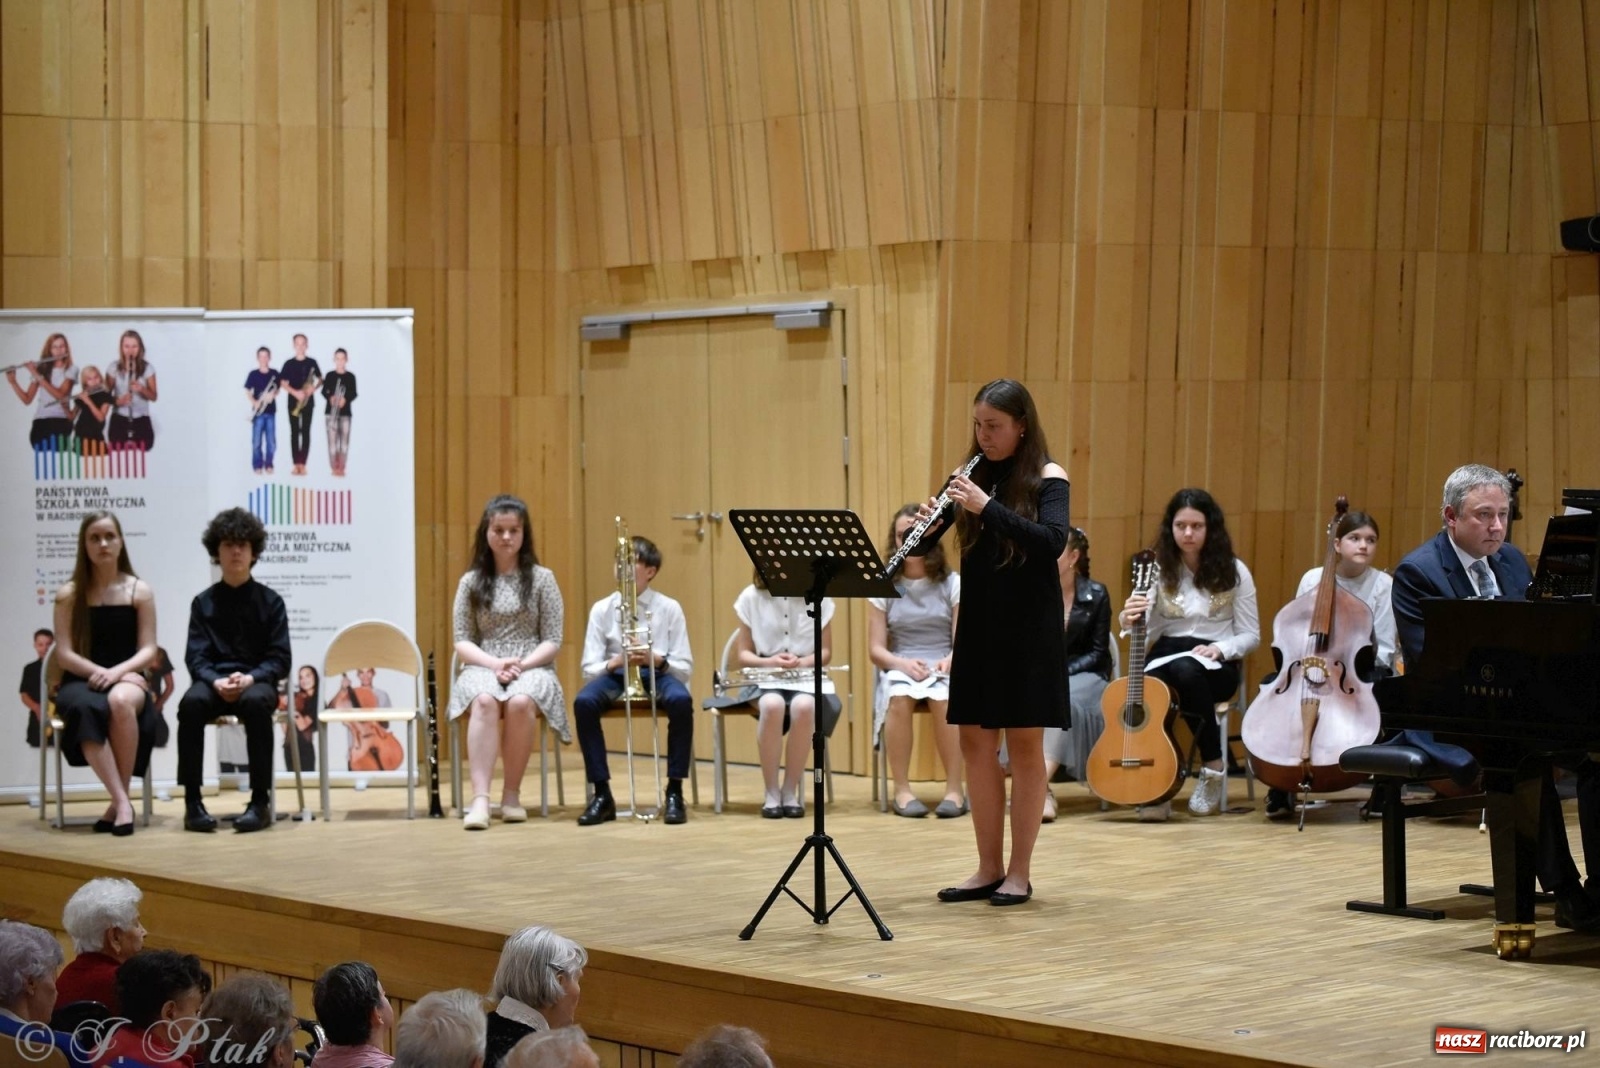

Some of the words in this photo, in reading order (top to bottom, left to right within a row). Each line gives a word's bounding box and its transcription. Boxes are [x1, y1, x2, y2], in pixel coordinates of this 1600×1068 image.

[35, 485, 110, 498] PAŃSTWOWA
[35, 498, 80, 510] SZKOŁA
[83, 496, 147, 509] MUZYCZNA
[36, 511, 45, 521] W
[293, 541, 352, 553] MUZYCZNA
[1463, 684, 1514, 699] YAMAHA
